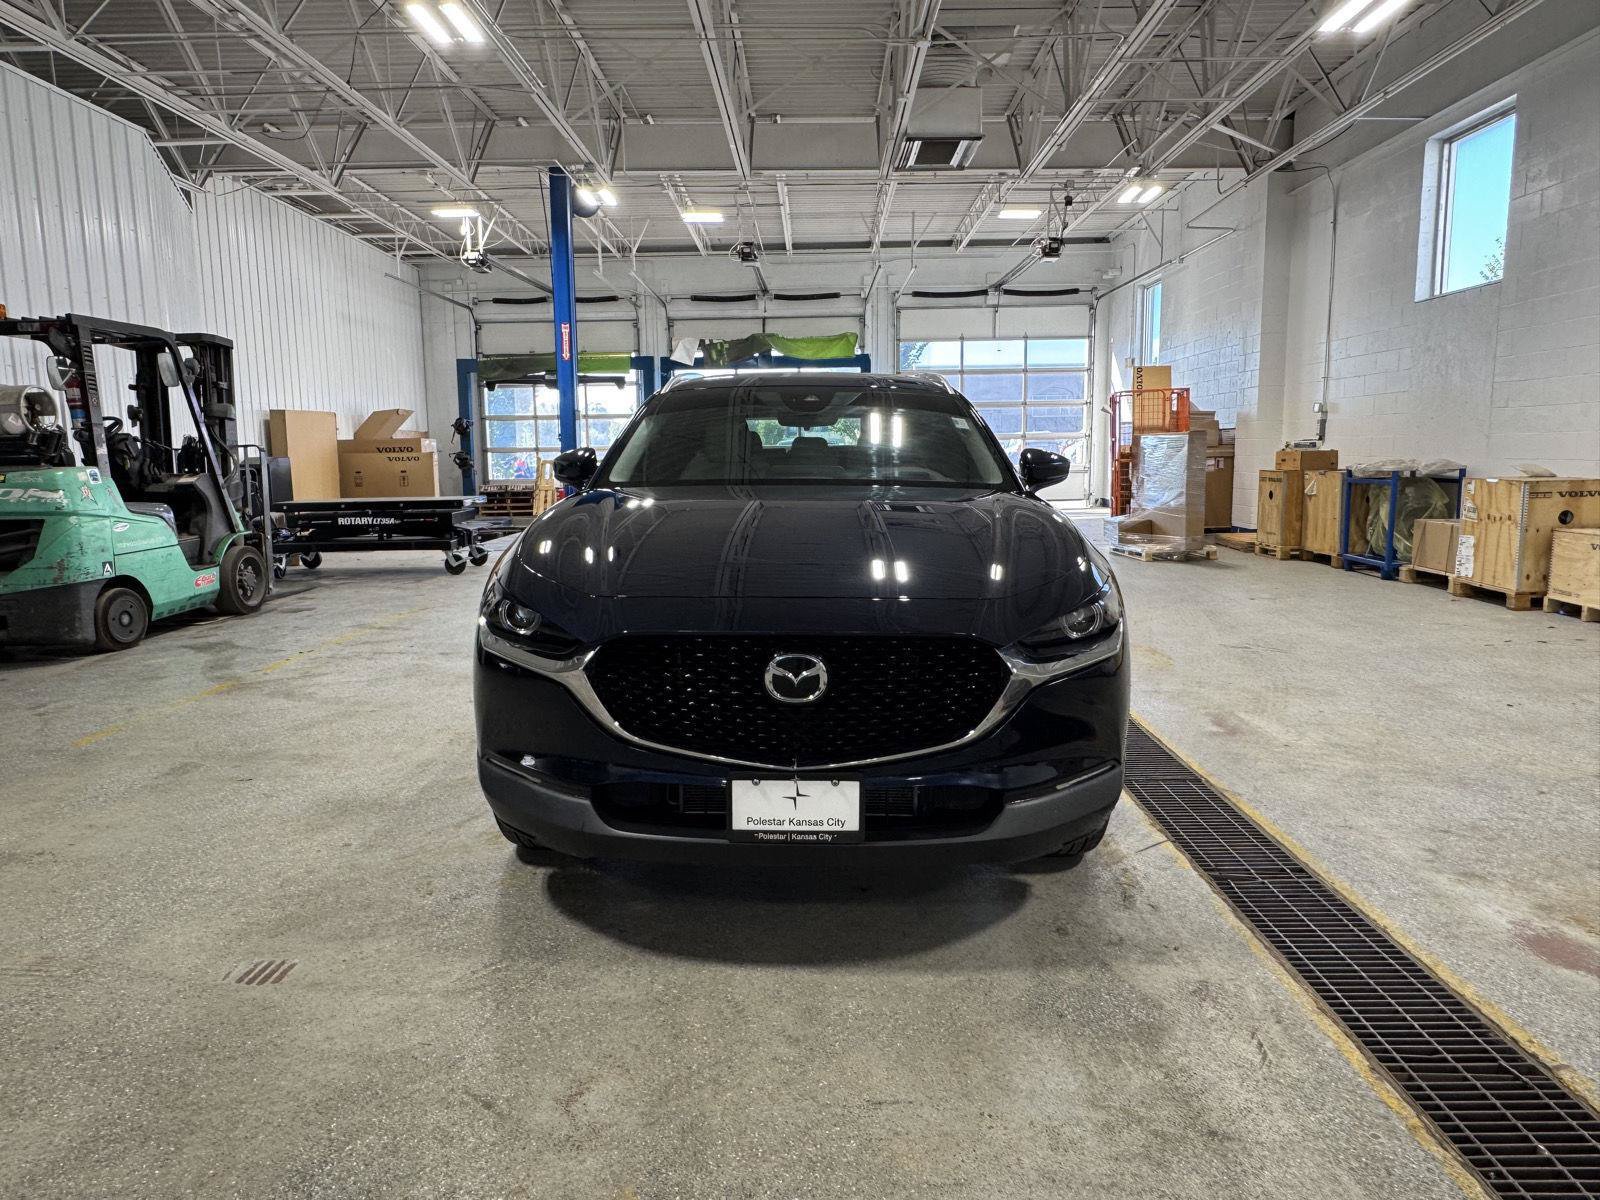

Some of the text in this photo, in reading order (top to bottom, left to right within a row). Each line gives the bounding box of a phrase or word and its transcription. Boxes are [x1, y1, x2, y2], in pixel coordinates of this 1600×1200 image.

[338, 517, 374, 525] ROTARY
[103, 563, 113, 576] A
[746, 816, 847, 829] Polestar Kansas City
[791, 833, 817, 841] Kansas
[818, 833, 833, 842] City
